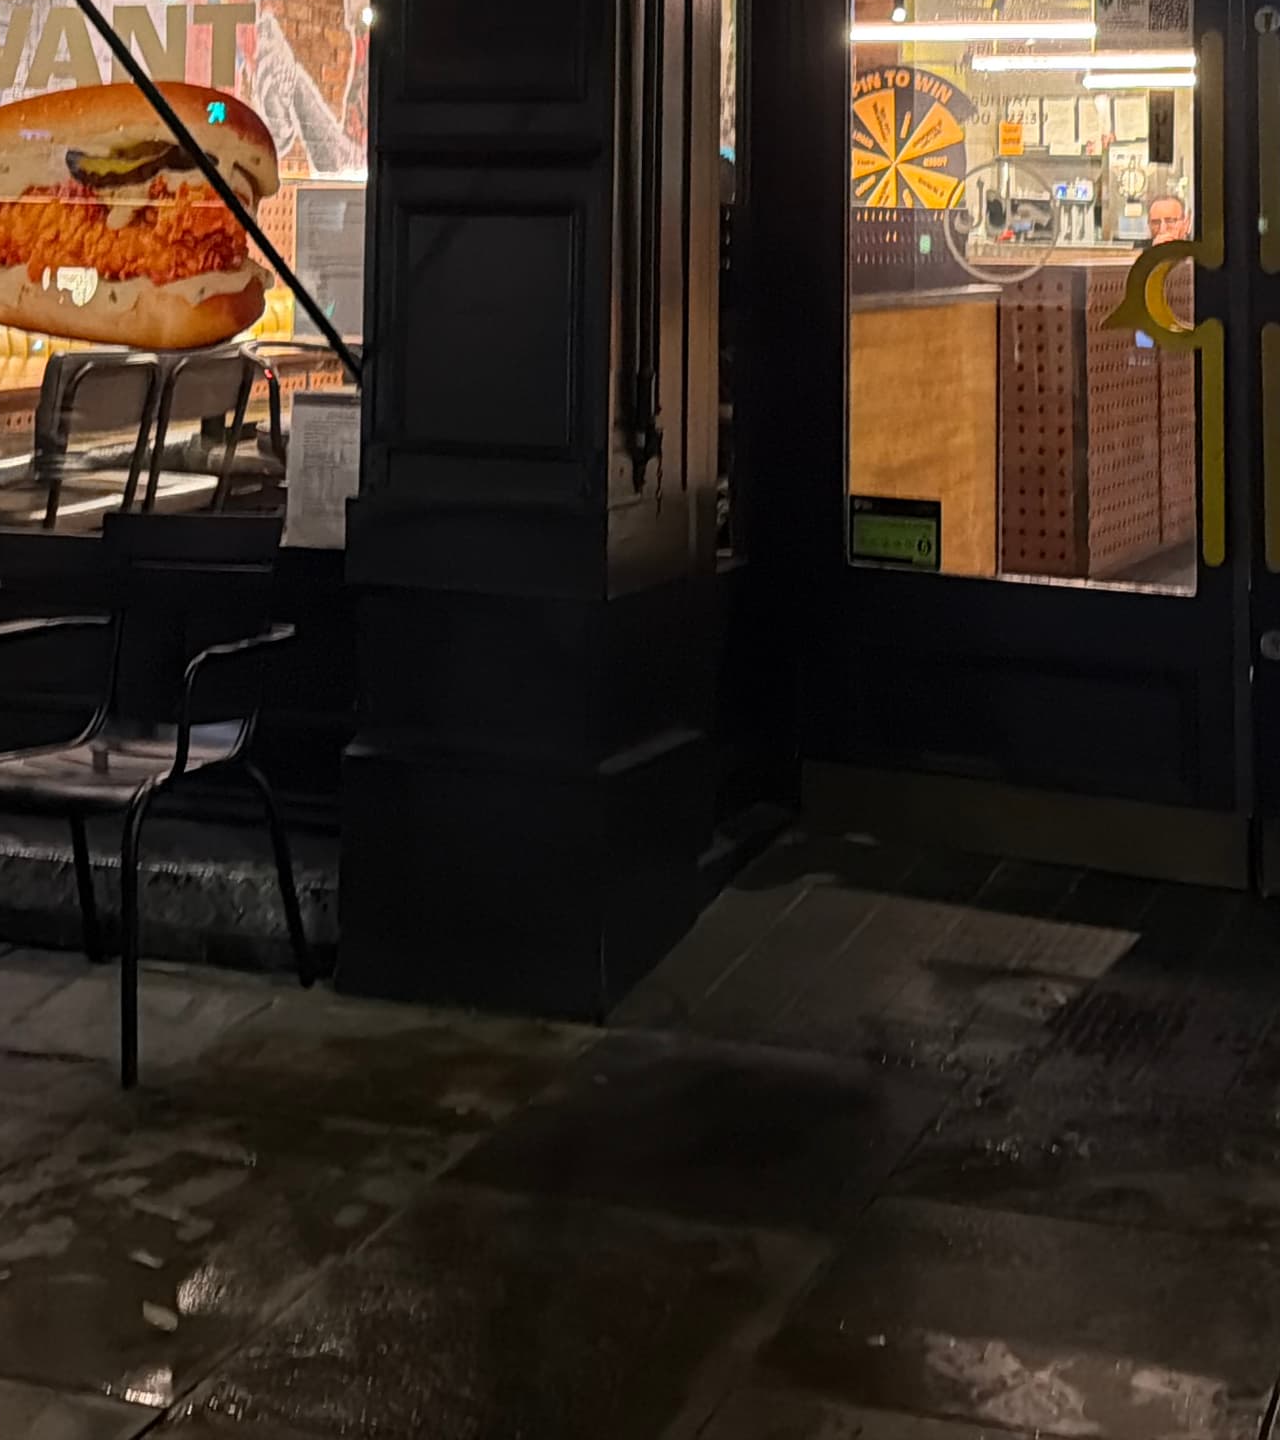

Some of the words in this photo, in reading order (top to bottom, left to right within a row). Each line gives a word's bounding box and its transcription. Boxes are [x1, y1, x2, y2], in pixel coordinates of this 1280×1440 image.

[853, 71, 882, 99] PIN
[883, 69, 911, 89] TO
[914, 73, 953, 105] WIN
